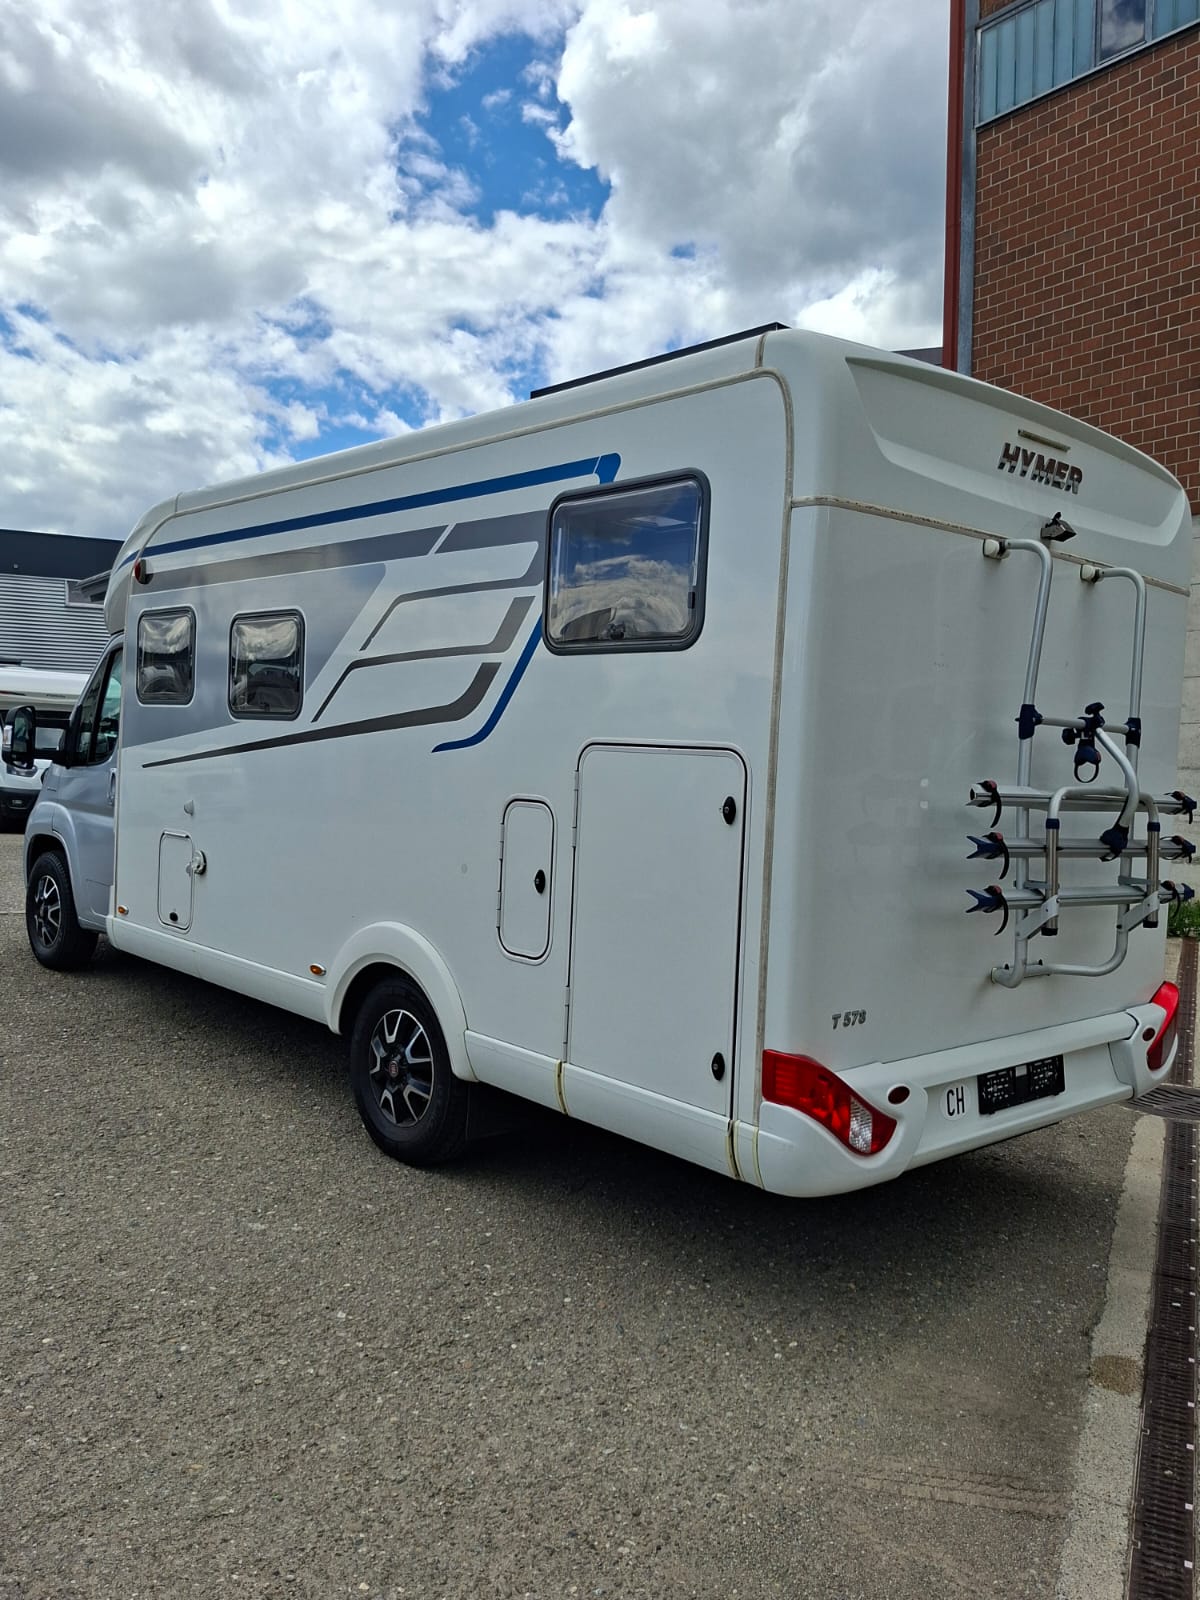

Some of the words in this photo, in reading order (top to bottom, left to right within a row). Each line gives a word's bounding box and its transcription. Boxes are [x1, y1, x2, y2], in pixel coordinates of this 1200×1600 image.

[998, 442, 1083, 495] HYMER
[832, 1013, 842, 1030] T
[946, 1086, 965, 1117] CH
